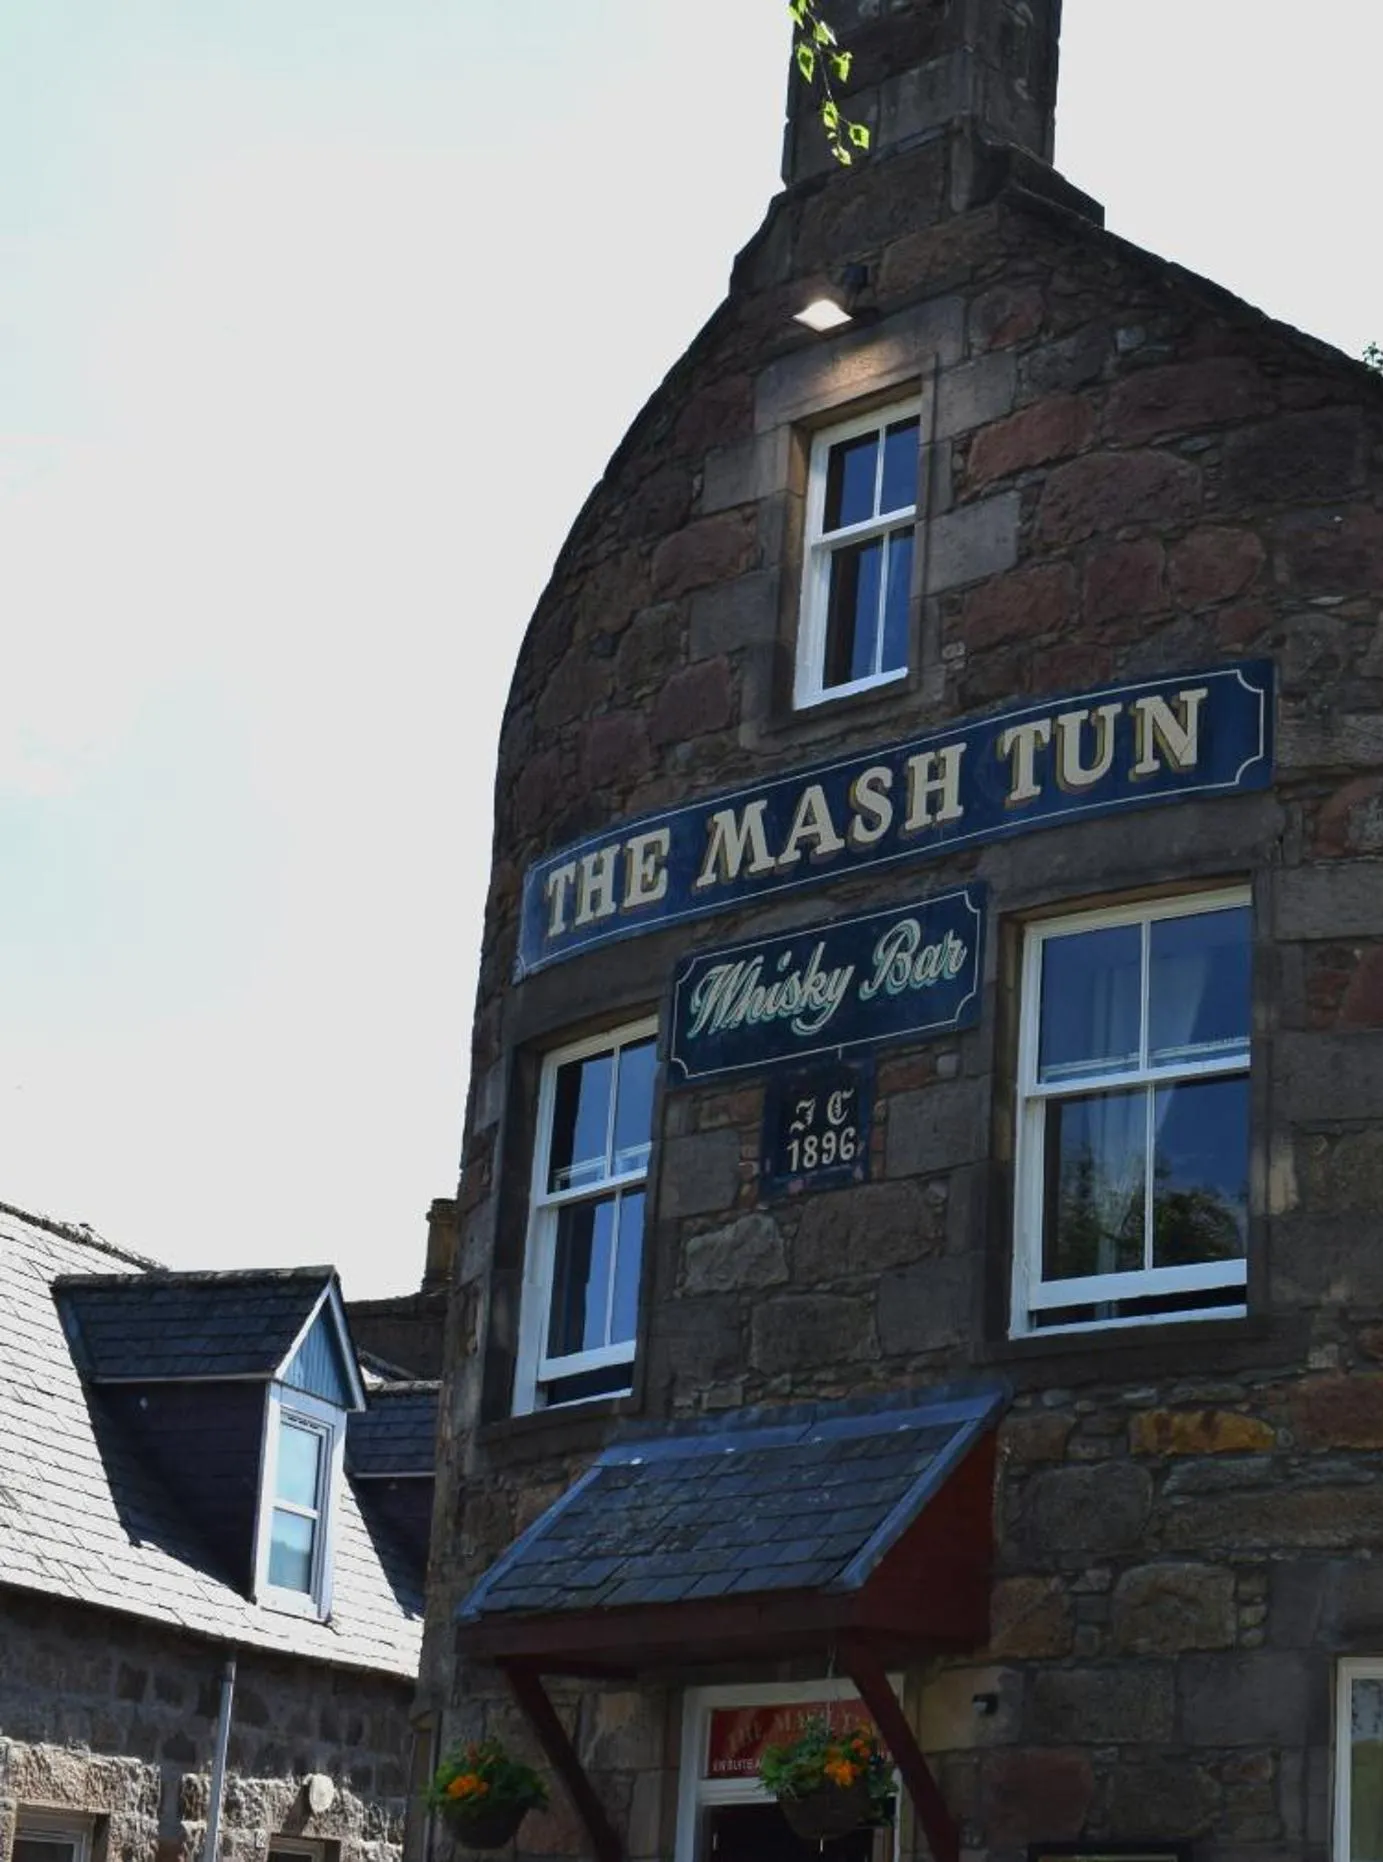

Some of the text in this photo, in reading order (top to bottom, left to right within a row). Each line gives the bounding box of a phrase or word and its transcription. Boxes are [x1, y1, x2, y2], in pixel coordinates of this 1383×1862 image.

[546, 687, 1208, 938] THE MASH TUN
[687, 918, 967, 1039] Whisky Bar
[786, 1126, 857, 1172] 1896
